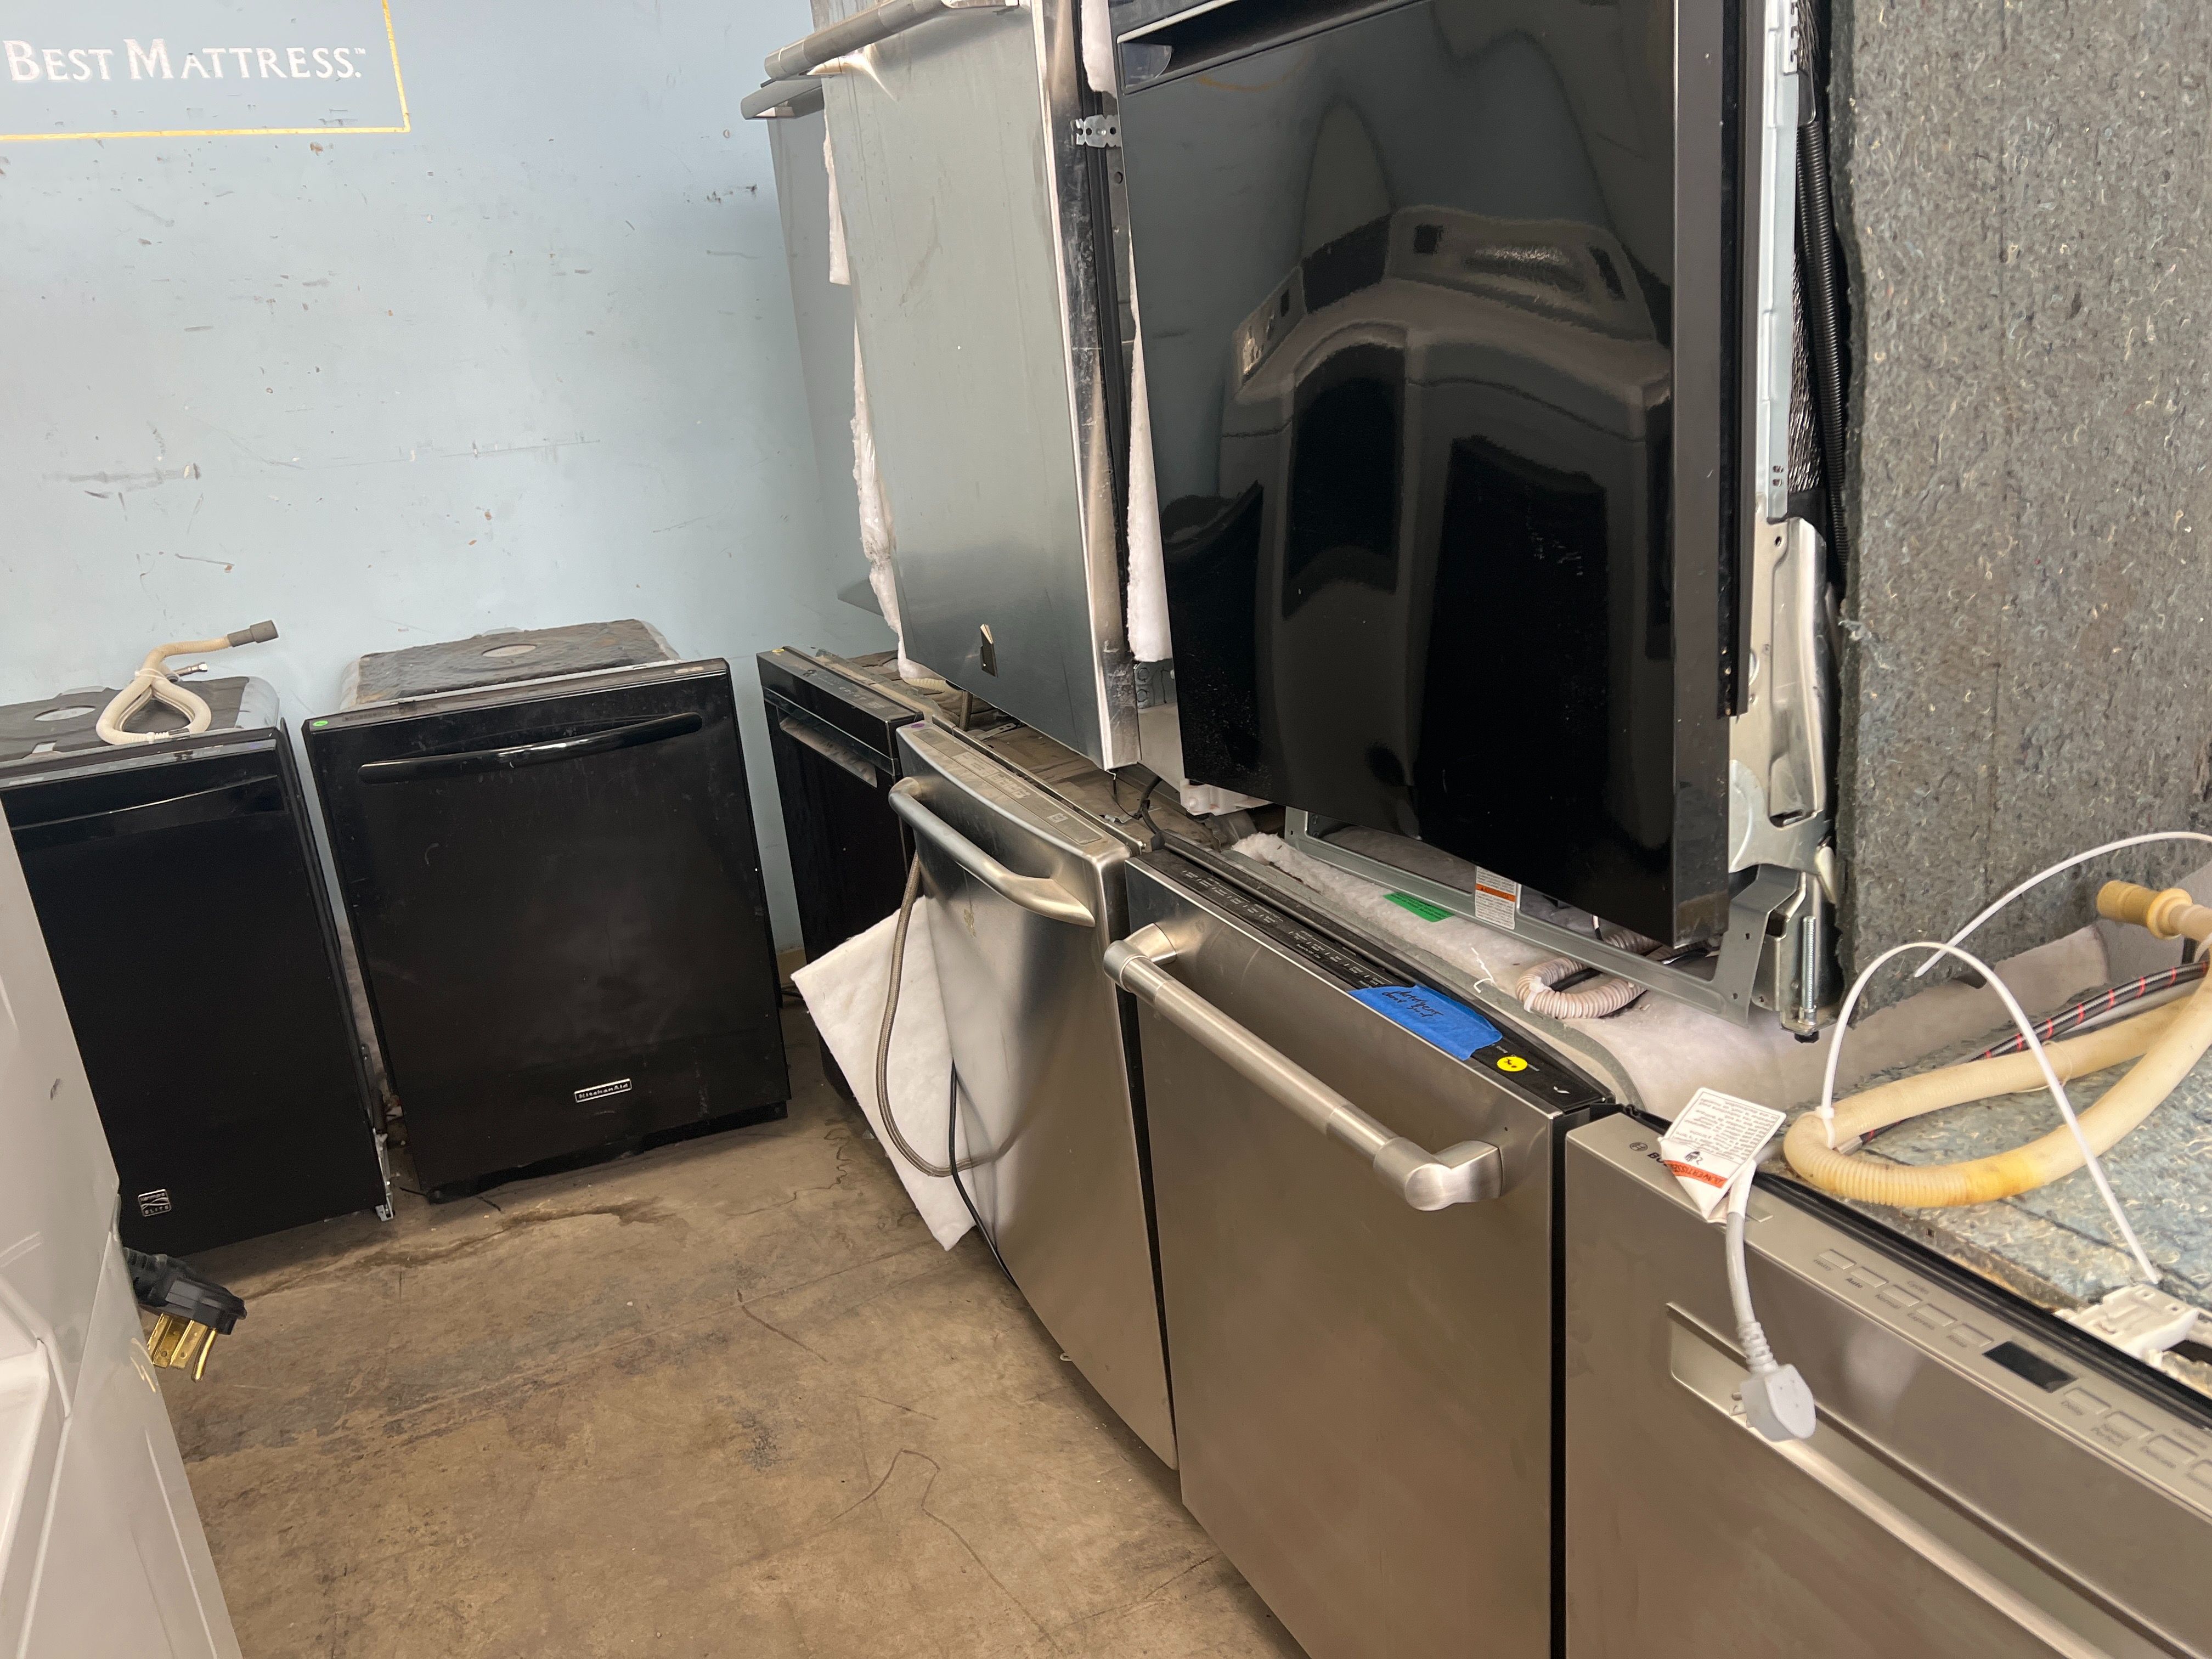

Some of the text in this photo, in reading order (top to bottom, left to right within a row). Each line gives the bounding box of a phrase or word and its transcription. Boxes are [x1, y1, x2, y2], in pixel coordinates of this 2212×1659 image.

[3, 40, 113, 82] BEST
[1671, 1164, 1712, 1182] AVERTISSE
[1846, 1277, 1863, 1289] Auto
[1875, 1294, 1901, 1310] Normal
